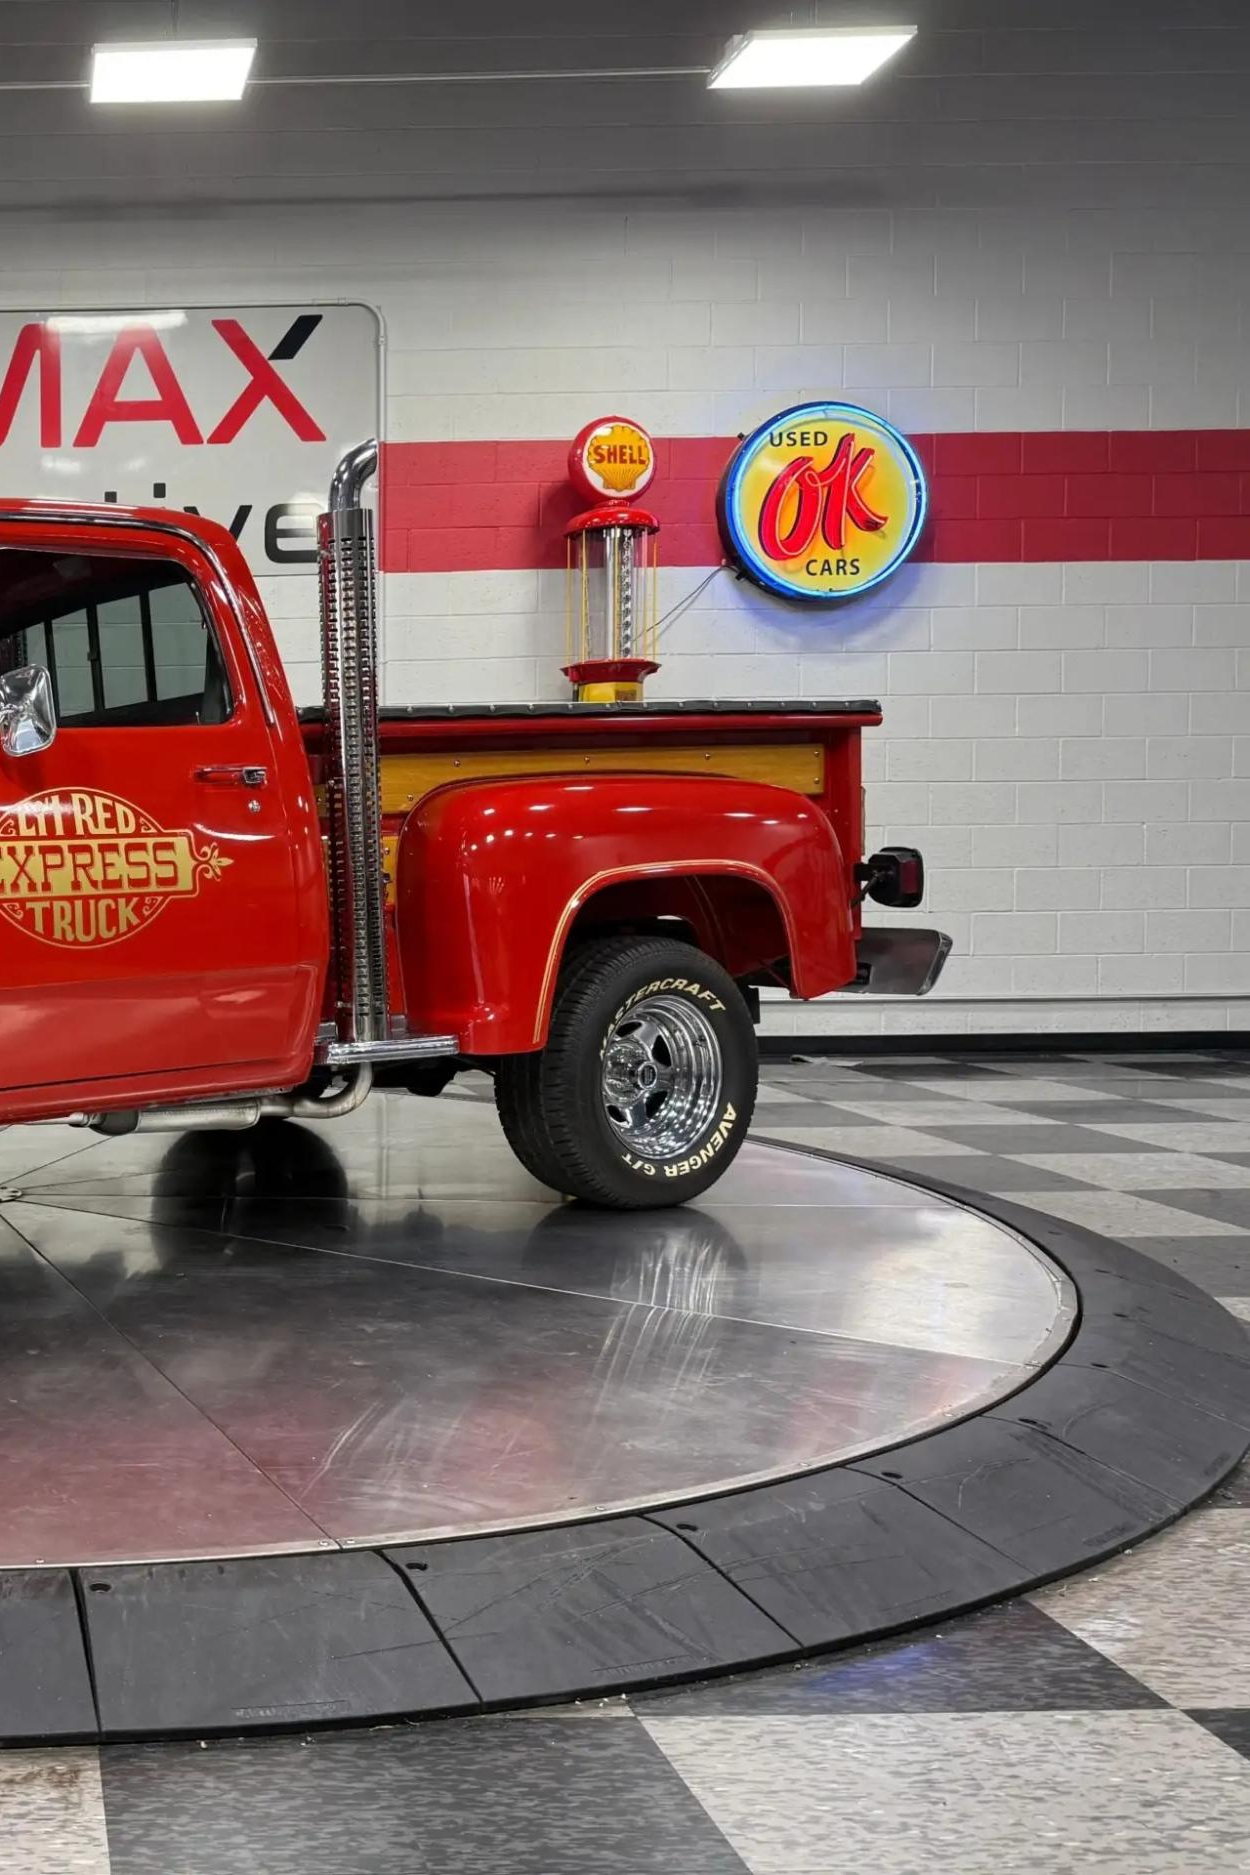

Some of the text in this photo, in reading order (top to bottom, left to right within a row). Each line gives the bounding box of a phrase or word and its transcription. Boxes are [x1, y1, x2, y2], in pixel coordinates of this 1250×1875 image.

[592, 443, 648, 466] SHELL
[769, 431, 828, 448] USED
[757, 432, 889, 562] OK
[804, 557, 861, 577] CARS
[70, 793, 136, 836] RED
[26, 896, 142, 943] TRUCK
[665, 1101, 738, 1178] AVENGER
